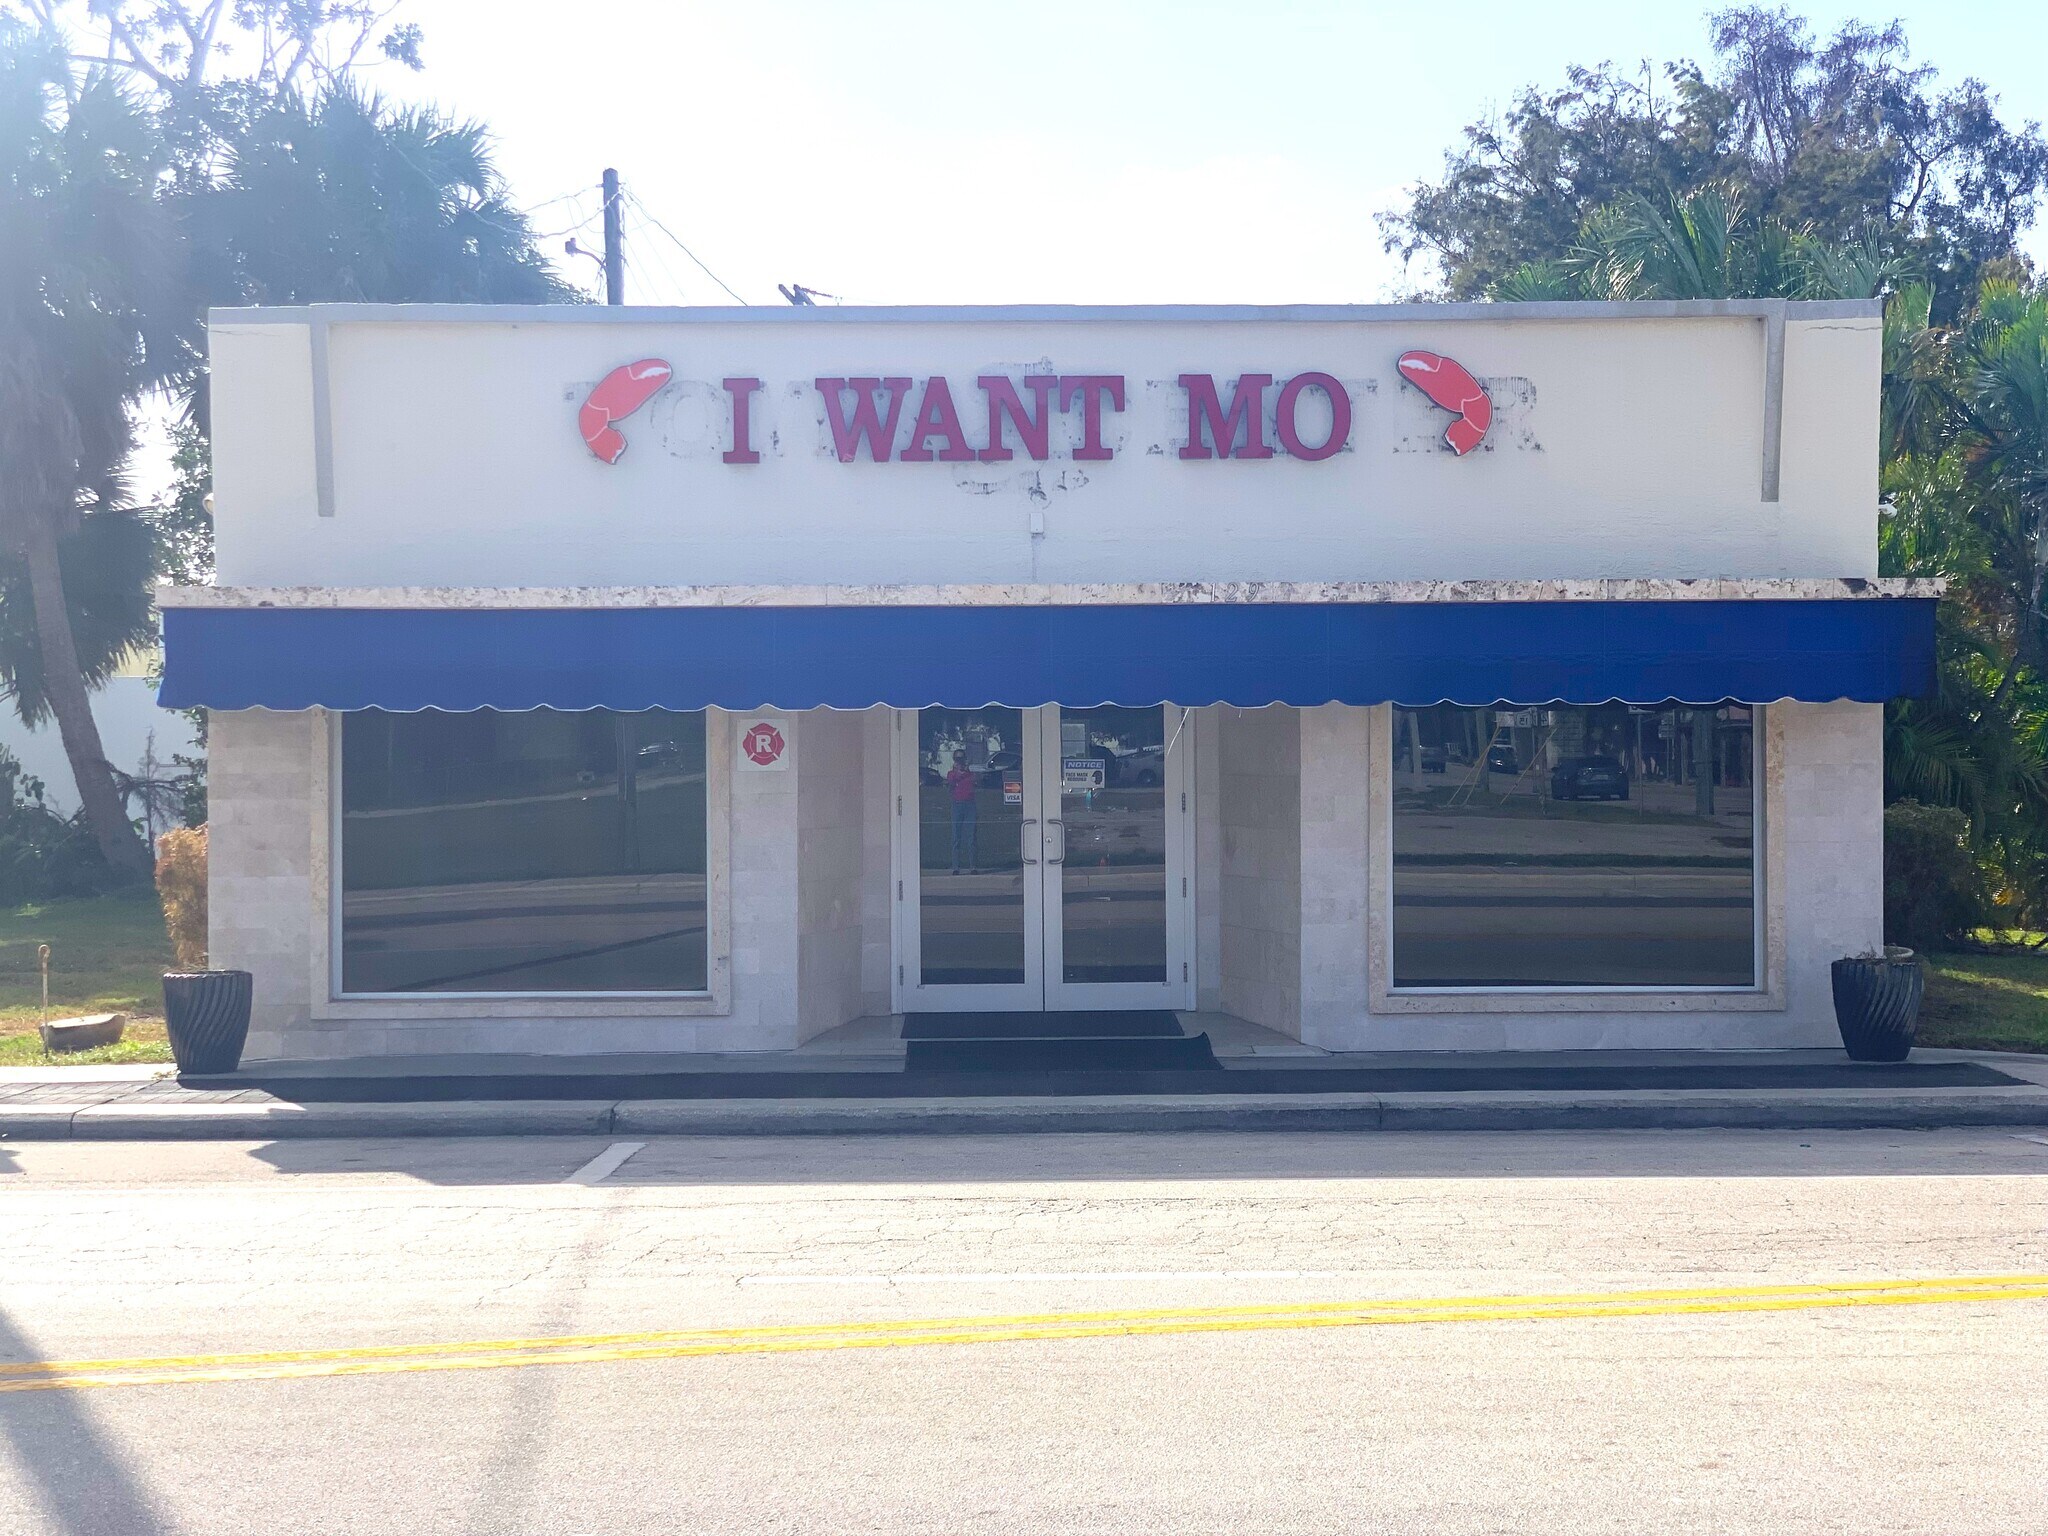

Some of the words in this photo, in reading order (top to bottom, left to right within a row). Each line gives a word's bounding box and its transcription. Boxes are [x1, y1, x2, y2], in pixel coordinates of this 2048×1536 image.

[722, 377, 761, 464] I
[814, 374, 1126, 463] WANT
[1177, 370, 1352, 462] MO
[1210, 582, 1260, 602] 129
[755, 734, 773, 753] R
